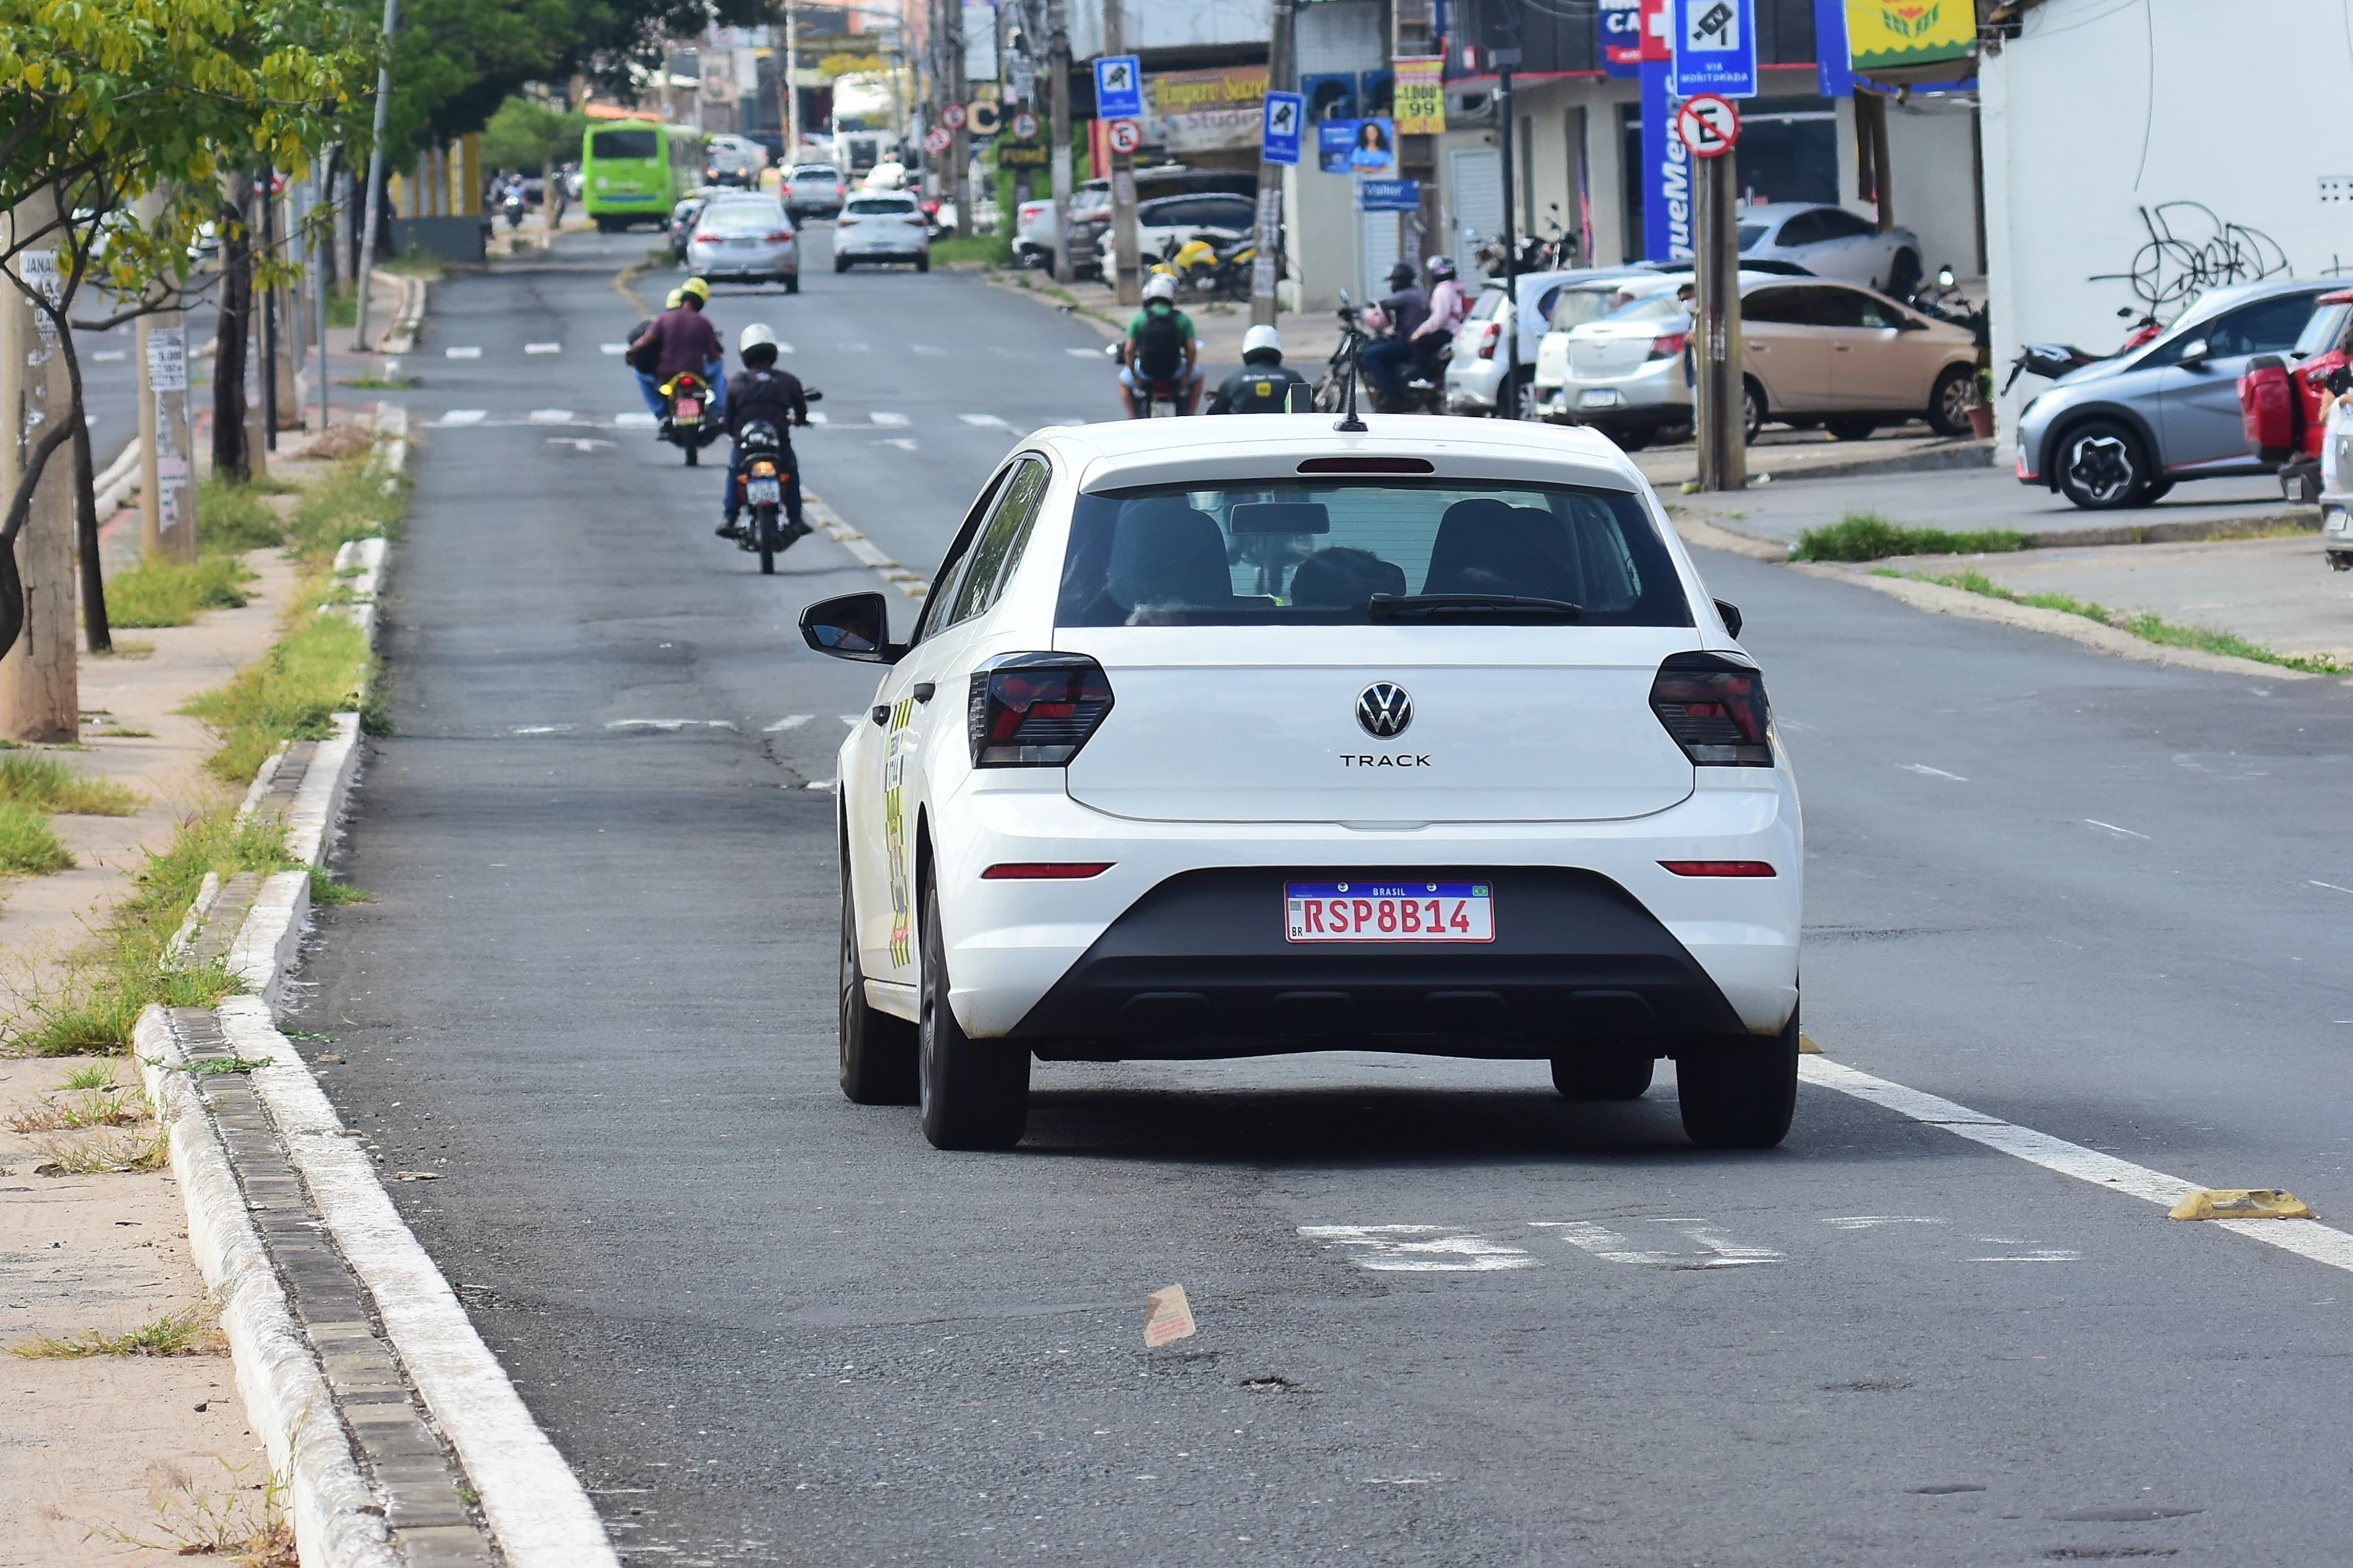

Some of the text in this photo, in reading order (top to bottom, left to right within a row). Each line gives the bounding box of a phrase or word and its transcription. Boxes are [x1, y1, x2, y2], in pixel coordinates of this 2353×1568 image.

[1705, 62, 1723, 71] VIA
[1680, 72, 1748, 83] MONITORADA
[1339, 754, 1432, 767] TRACK
[1373, 887, 1406, 896] BRASIL
[1304, 900, 1469, 933] RSP8B14
[1291, 927, 1303, 937] BR
